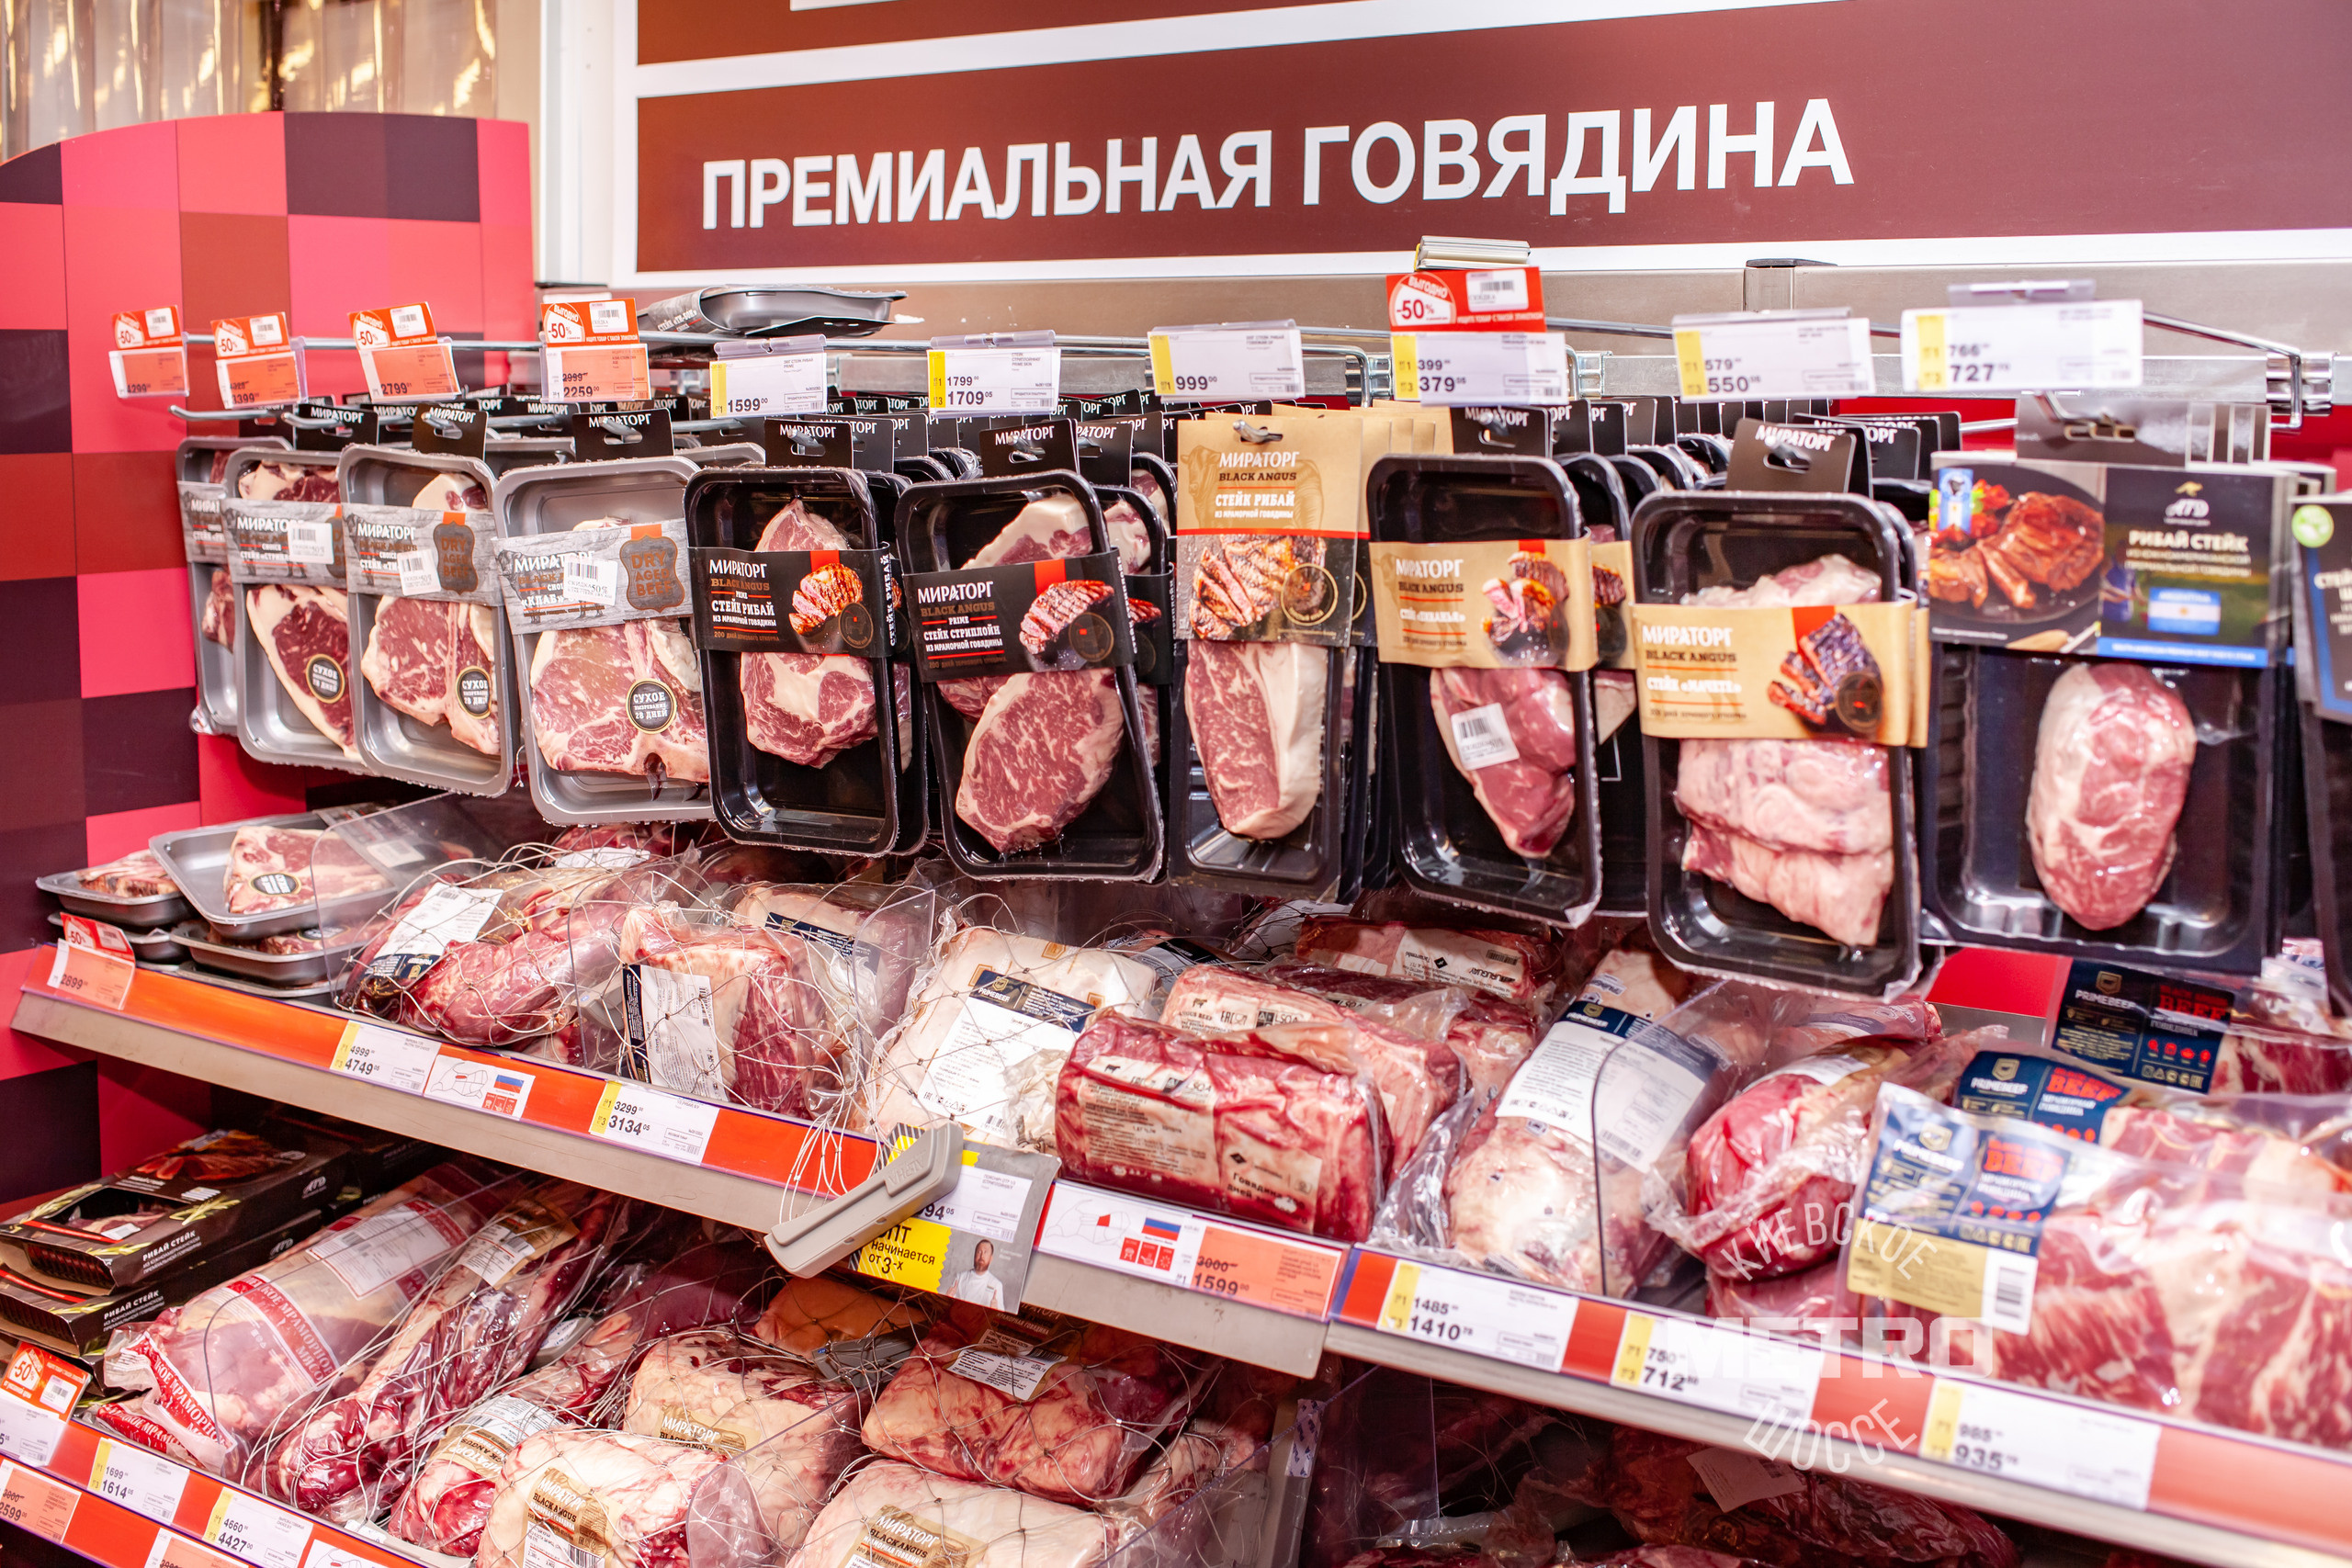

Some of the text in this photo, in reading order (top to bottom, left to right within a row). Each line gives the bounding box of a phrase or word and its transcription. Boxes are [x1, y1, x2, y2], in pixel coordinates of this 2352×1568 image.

[703, 98, 1855, 229] ПРЕМИАЛЬНАЯ ГОВЯДИНА
[1408, 276, 1447, 299] ВЫГОДНО
[1418, 359, 1442, 370] 399
[1704, 359, 1733, 370] 579
[947, 376, 973, 387] 1799
[1950, 365, 1996, 383] 727
[380, 383, 407, 394] 2799
[1175, 376, 1208, 390] 999
[1419, 377, 1455, 392] 379
[1708, 377, 1748, 393] 550
[563, 386, 593, 398] 2259
[947, 390, 984, 405] 1709
[373, 405, 418, 416] МИРАТО
[728, 398, 761, 413] 1599
[311, 406, 364, 423] МИРАТОРГ
[429, 407, 476, 423] МИРАТОРГ
[1077, 425, 1117, 439] РАТОРГ
[1219, 451, 1300, 468] МИРАТОРГ
[1218, 472, 1297, 481] BLACK ANGUS
[1216, 491, 1295, 506] СТЕЙК РИБАЙ
[1223, 508, 1259, 518] МРАМОРНОЙ
[1259, 510, 1294, 519] ГОВЯДИНЫ
[357, 523, 416, 540] МИРАТОРГ
[441, 537, 467, 551] DRY
[2129, 530, 2249, 552] РИБАЙ СТЕЙК
[359, 558, 382, 570] СТЕЙК
[631, 550, 666, 570] DRY
[443, 565, 469, 578] BEEF
[635, 568, 670, 582] AGED
[709, 558, 767, 579] МИРАТОРГ
[637, 581, 673, 596] BEEF
[711, 578, 770, 591] BLACK ANGUS
[918, 581, 993, 604] МИРАТОРГ
[1422, 582, 1464, 593] ANGUS
[711, 597, 775, 616] СТЕЙК РИБАЙ
[921, 602, 996, 617] BLACK ANGUS
[948, 616, 969, 626] PRIME
[923, 625, 1001, 641] СТЕЙК СТРИПЛОЙН
[1643, 625, 1733, 648] МИРАТОРГ
[933, 639, 969, 652] МРАМОРНОЙ
[969, 637, 1003, 649] ГОВЯДИНЫ
[1645, 650, 1737, 663] BLACK ANGUS
[312, 664, 338, 680] СУХОЕ
[462, 680, 488, 690] СУХОЕ
[633, 692, 665, 704] СУХОЕ
[635, 708, 668, 719] 28 ДНЕЙ
[61, 974, 85, 990] 2899
[978, 987, 1011, 1003] PRIMEBEEF
[2075, 988, 2137, 1010] PRIMEBEEF
[351, 1045, 370, 1057] 4999
[345, 1058, 374, 1076] 4749
[1971, 1077, 2029, 1095] PRIMEBEEF
[2046, 1074, 2122, 1101] BEEF
[615, 1101, 638, 1115] 3299
[609, 1115, 643, 1136] 3134
[1984, 1149, 2063, 1182] BEEF
[1233, 1171, 1283, 1200] Говядина
[142, 1242, 170, 1261] РИБАЙ
[170, 1230, 197, 1247] СТЕЙК
[871, 1240, 935, 1265] начинается
[868, 1253, 882, 1265] от
[1197, 1256, 1229, 1272] 3000
[1194, 1272, 1238, 1295] 1599
[133, 1290, 159, 1306] СТЕЙК
[1414, 1297, 1449, 1314] 1485
[1410, 1314, 1461, 1341] 1410
[279, 1302, 336, 1376] МРАМОРНОЕ
[296, 1346, 324, 1381] МЯСО
[1643, 1365, 1686, 1392] 712
[662, 1416, 720, 1443] МИРАТОРГ
[460, 1438, 491, 1456] ANGUS
[1956, 1444, 2003, 1472] 935
[106, 1466, 124, 1480] 1699
[102, 1479, 128, 1500] 1614
[537, 1478, 587, 1511] МИРАТОРГ
[533, 1493, 577, 1523] BLACK ANGUS
[223, 1517, 243, 1533] 4660
[876, 1516, 939, 1548] МИРАТОРГ
[218, 1533, 247, 1552] 4427
[870, 1528, 928, 1558] BLACK ANGUS
